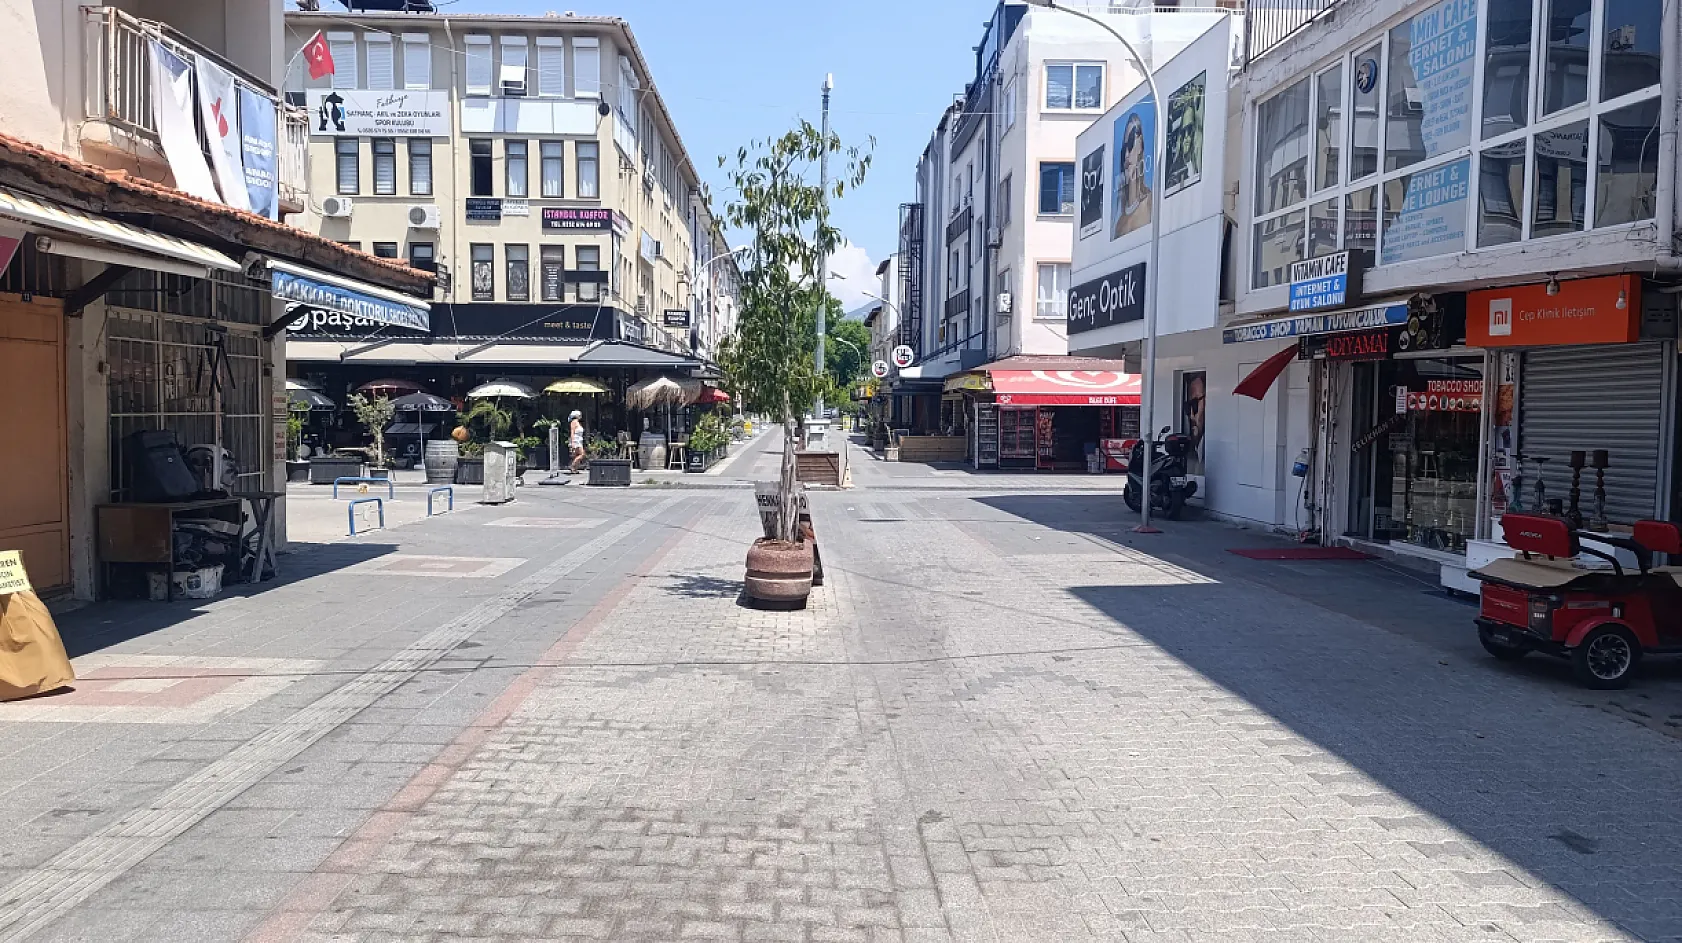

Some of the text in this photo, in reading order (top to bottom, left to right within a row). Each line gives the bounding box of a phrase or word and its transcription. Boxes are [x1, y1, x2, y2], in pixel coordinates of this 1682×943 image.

[1458, 25, 1467, 41] &
[1423, 40, 1474, 76] SALONU
[1451, 165, 1459, 180] &
[1419, 181, 1466, 208] LOUNGE
[1326, 253, 1345, 276] CAFE
[1334, 279, 1340, 290] &
[1070, 271, 1136, 325] Genç Optik
[1292, 292, 1343, 310] OYUN SALONU
[1519, 310, 1535, 323] Cep
[1537, 307, 1560, 319] Klinik
[1234, 328, 1267, 342] TOBACCO
[1269, 324, 1292, 336] SHOP
[1294, 316, 1324, 334] YAMAN
[1428, 380, 1462, 392] TOBACCO
